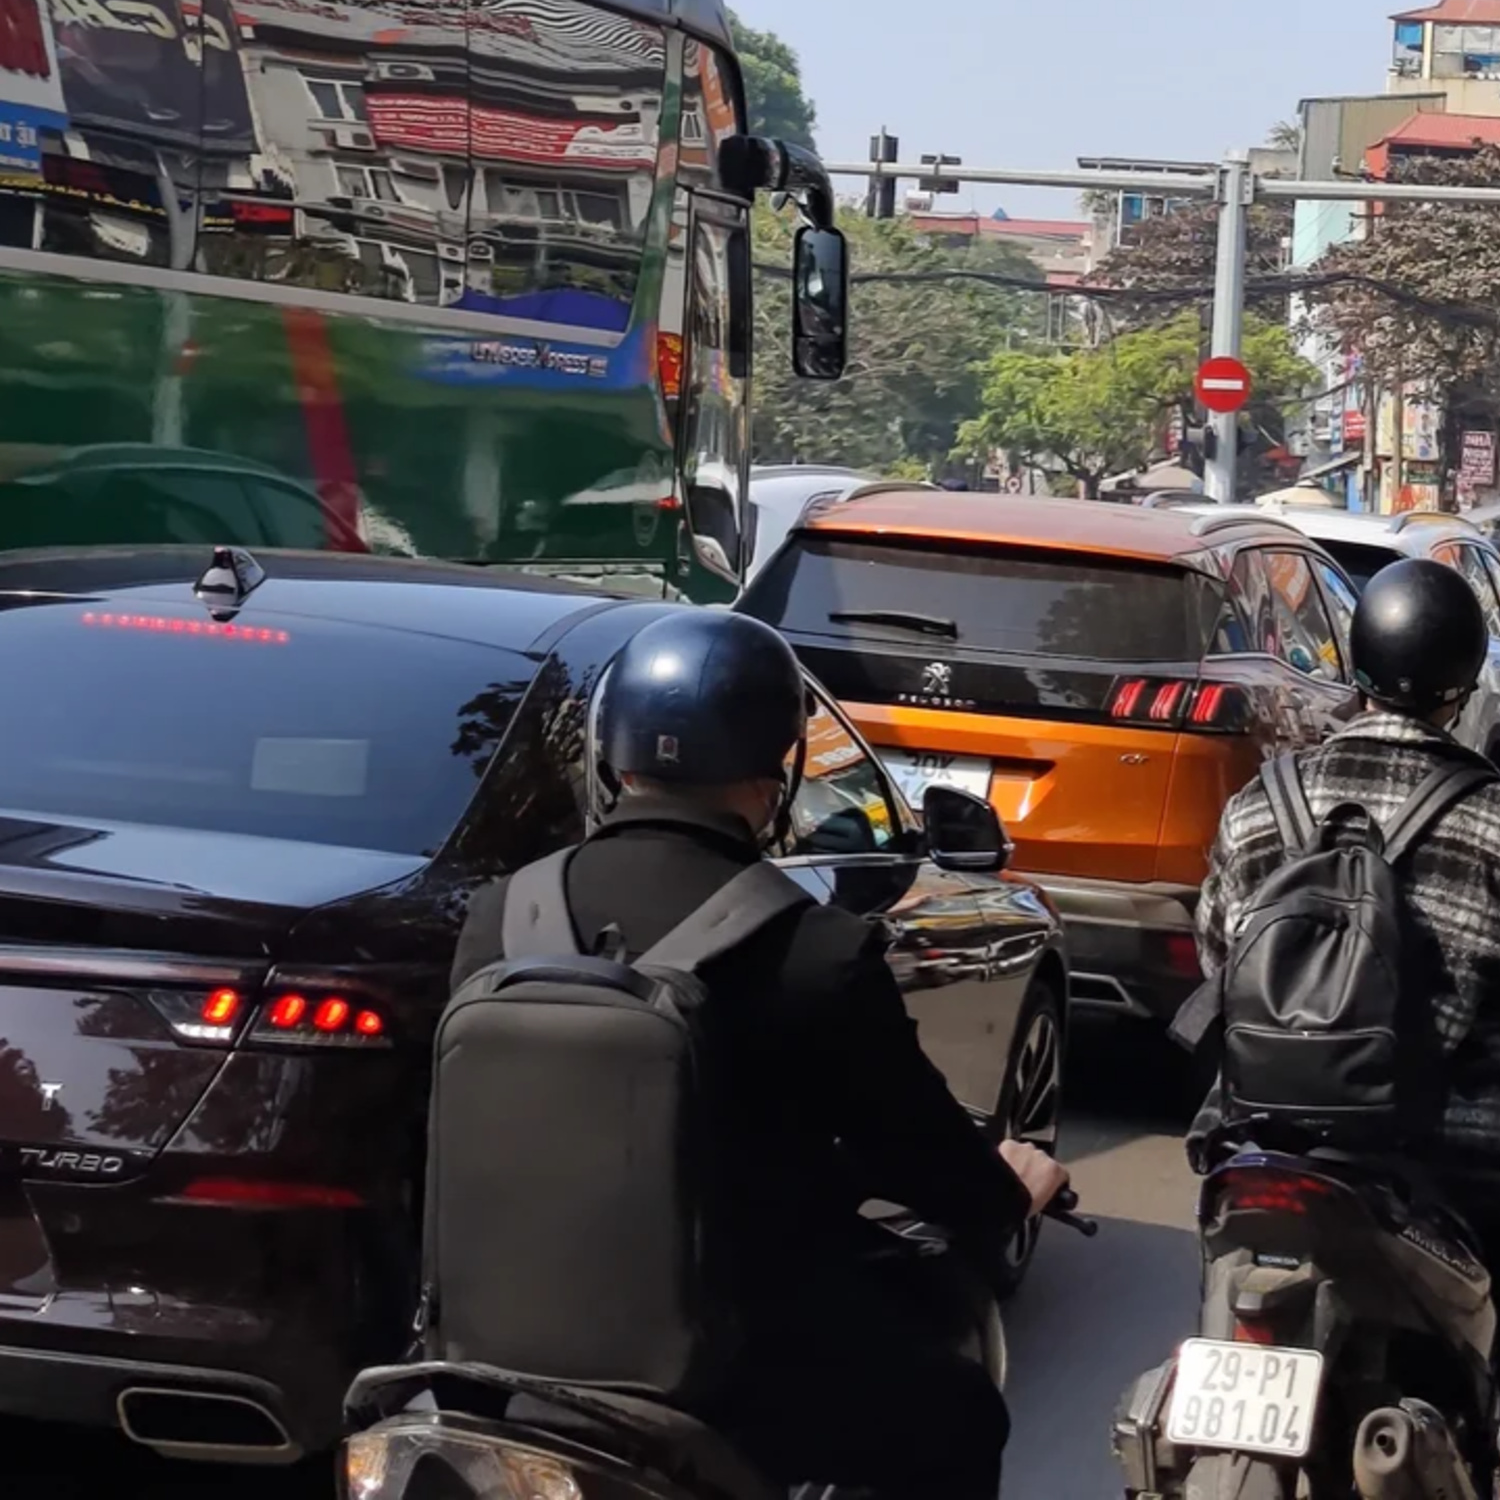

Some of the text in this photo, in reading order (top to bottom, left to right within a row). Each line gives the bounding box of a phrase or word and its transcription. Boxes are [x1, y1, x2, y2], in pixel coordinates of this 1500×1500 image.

[19, 1147, 123, 1173] TURBO
[1257, 1253, 1300, 1267] HONDA
[1200, 1350, 1298, 1399] 29-P1
[1181, 1395, 1300, 1447] 981.04
